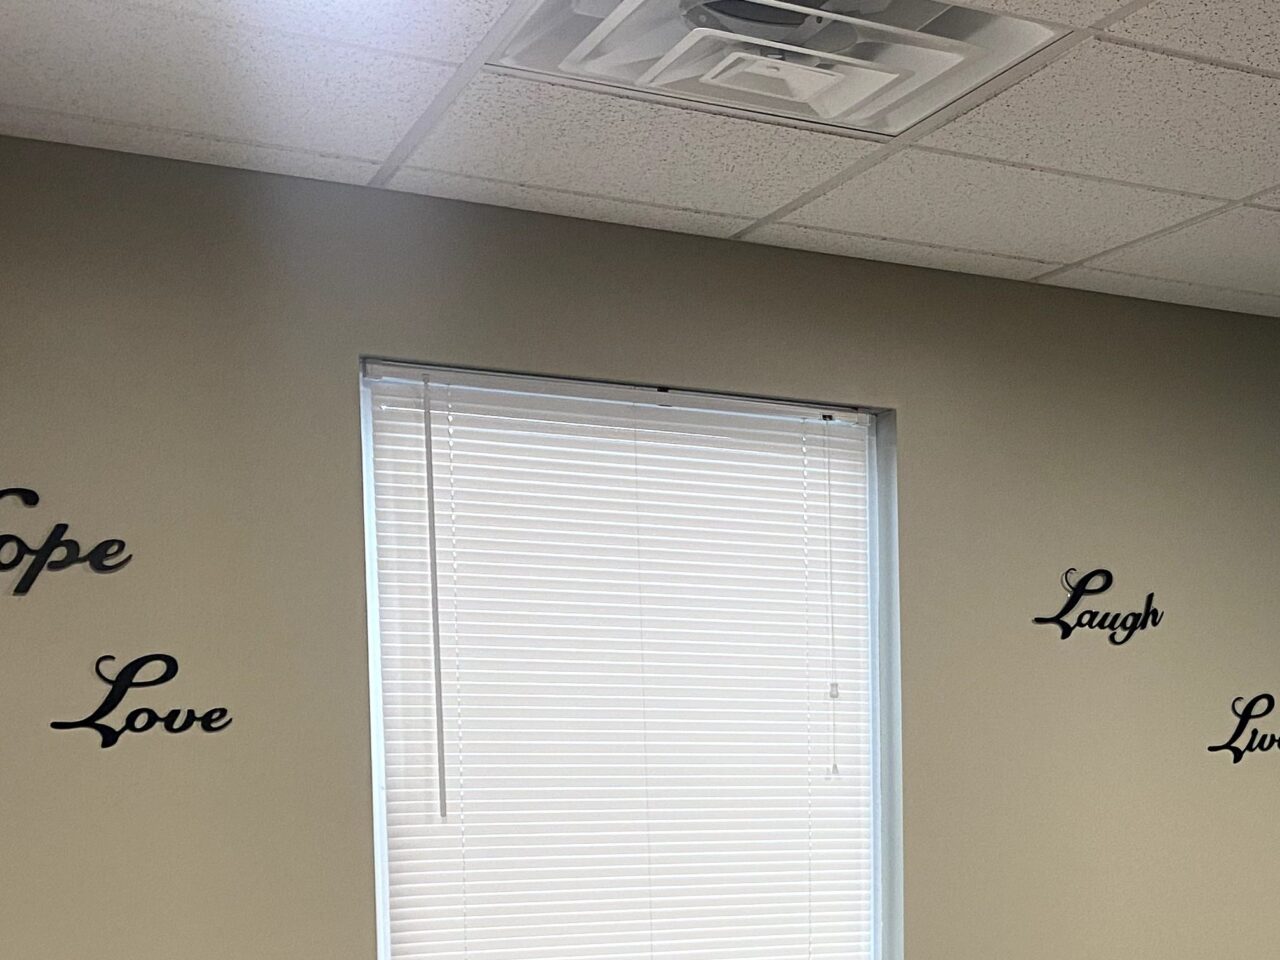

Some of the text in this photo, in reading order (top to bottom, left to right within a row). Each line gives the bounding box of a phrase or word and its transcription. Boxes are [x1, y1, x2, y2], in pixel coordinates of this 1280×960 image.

[0, 487, 133, 596] ope
[1033, 567, 1165, 646] Laugh
[50, 653, 233, 749] Love
